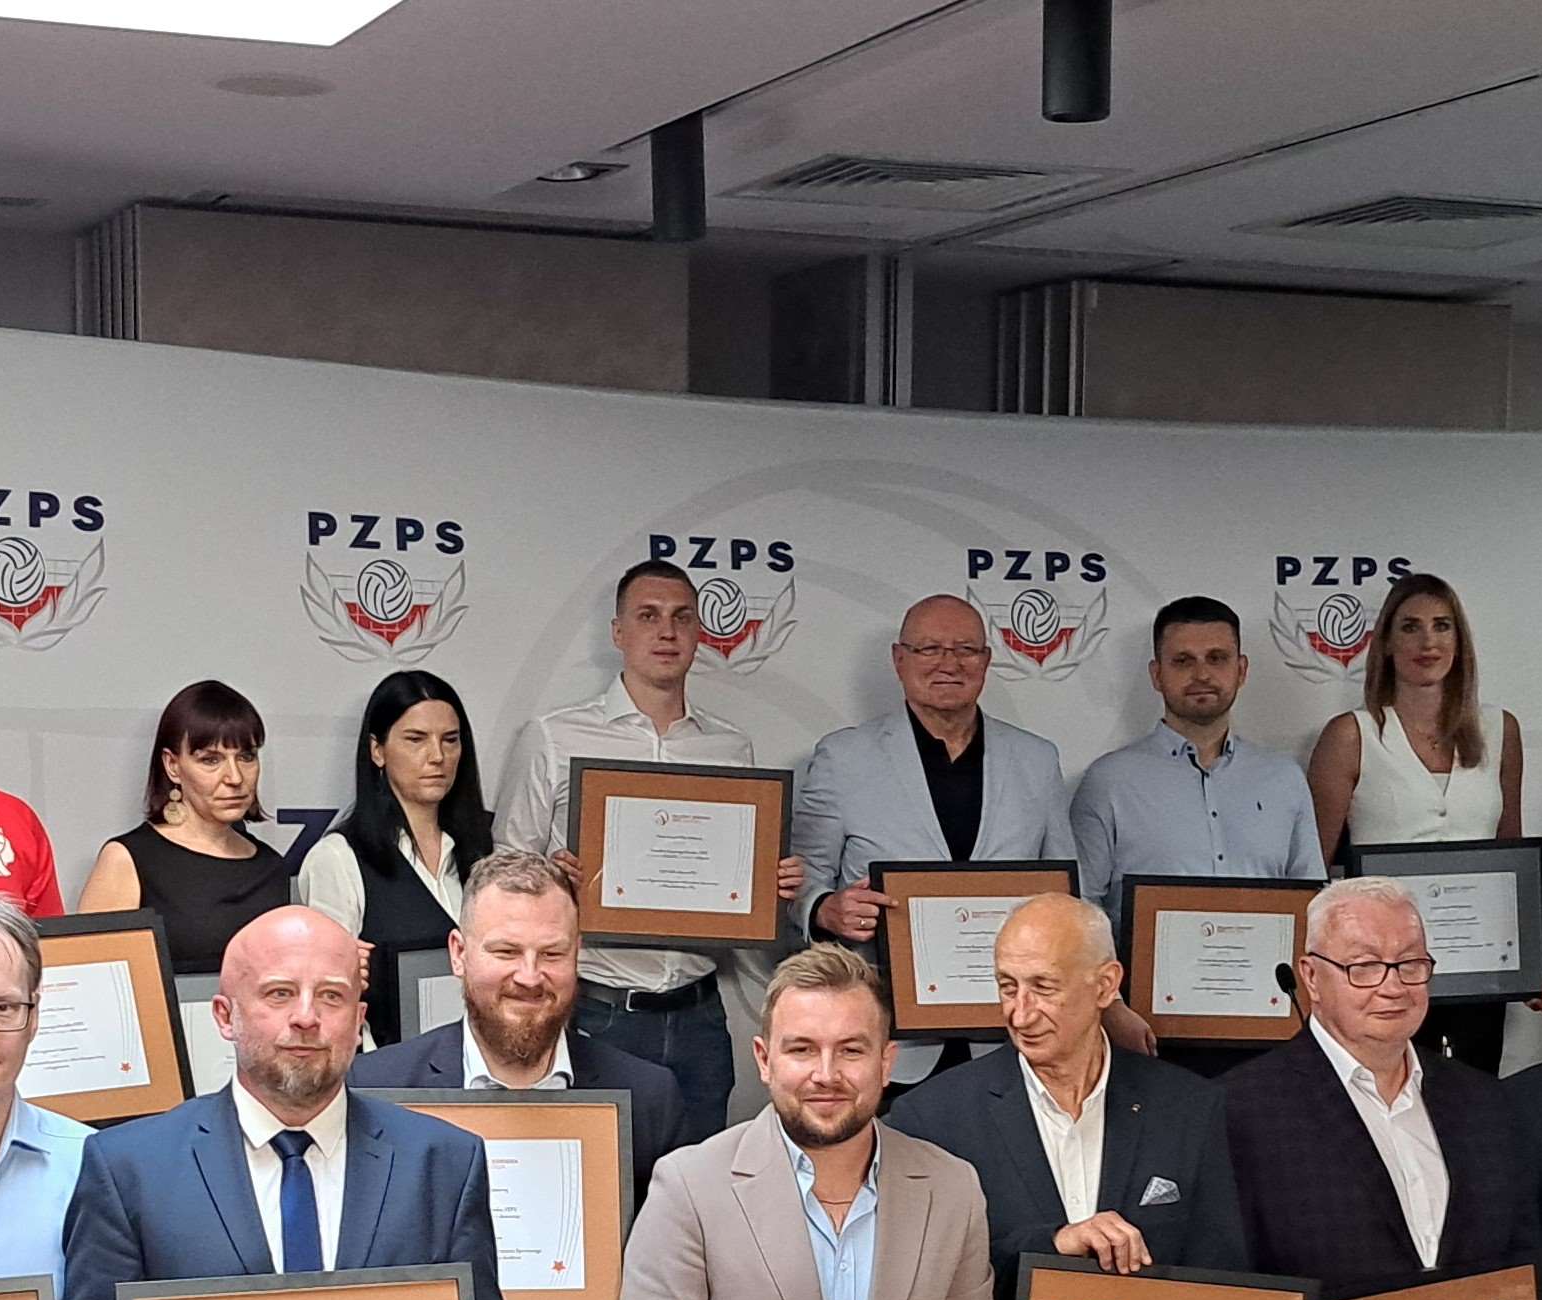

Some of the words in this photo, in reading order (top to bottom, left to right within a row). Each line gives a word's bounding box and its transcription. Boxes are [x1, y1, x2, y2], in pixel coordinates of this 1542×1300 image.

[308, 511, 466, 555] PZPS
[649, 534, 795, 573] PZPS
[967, 548, 1107, 583] PZPS
[1276, 555, 1413, 586] PZPS
